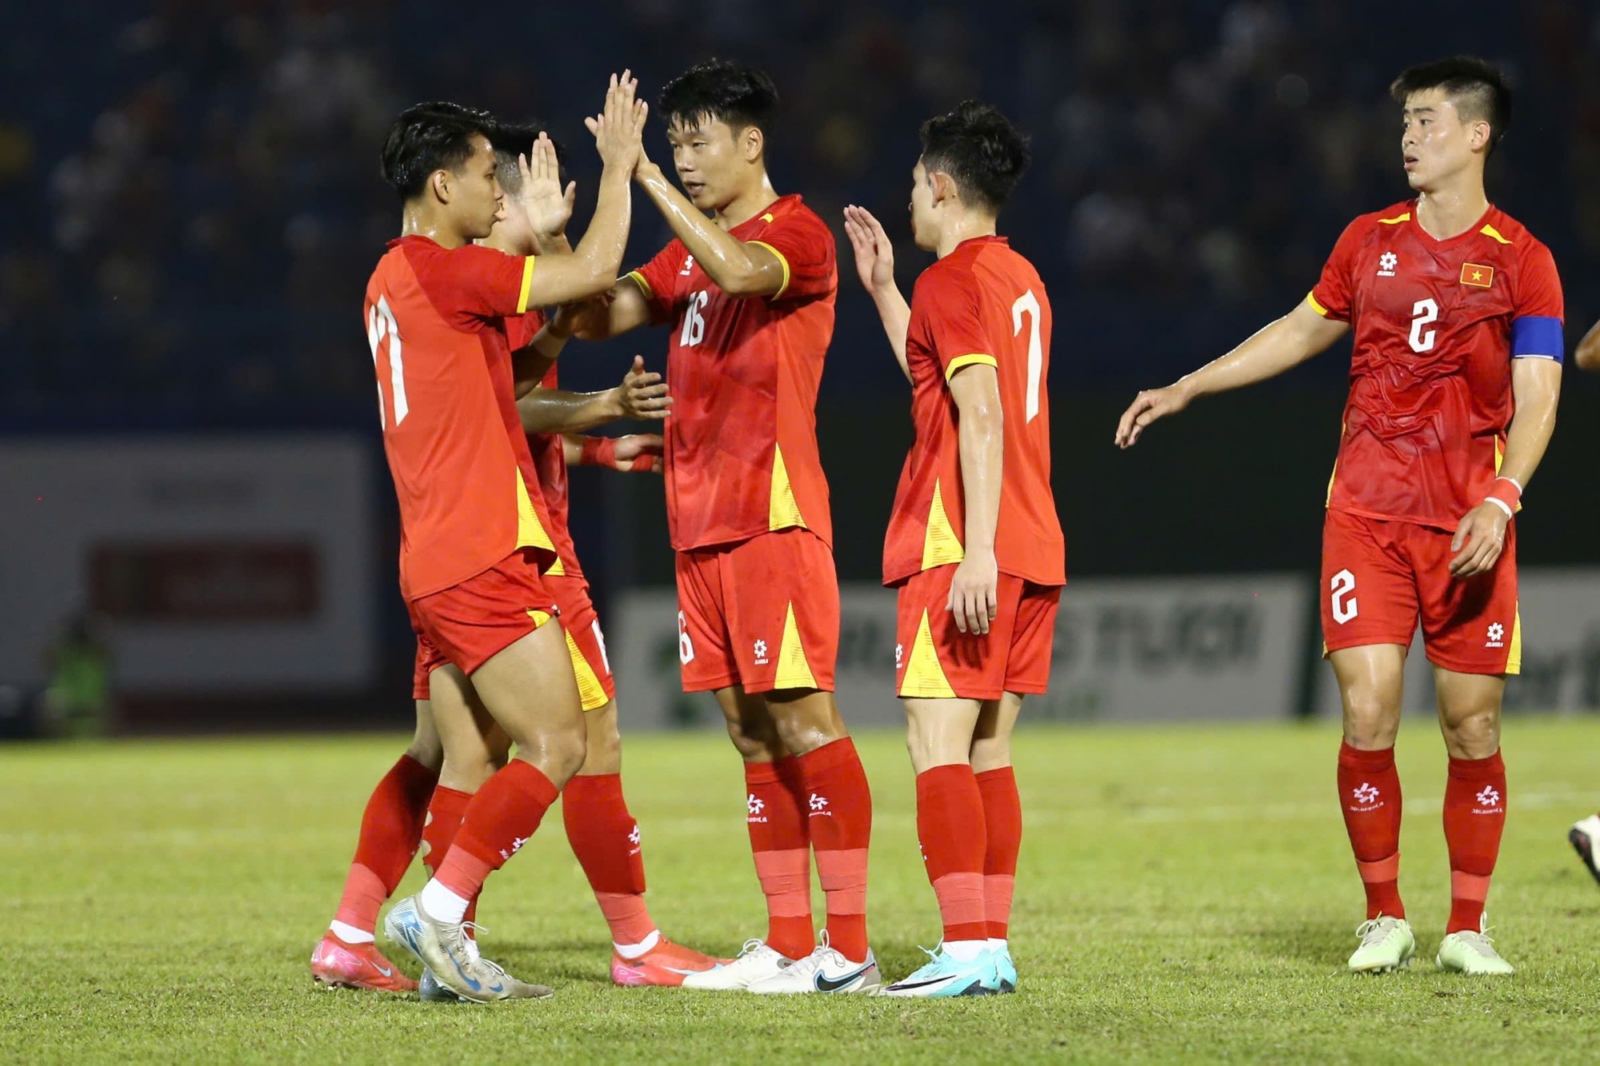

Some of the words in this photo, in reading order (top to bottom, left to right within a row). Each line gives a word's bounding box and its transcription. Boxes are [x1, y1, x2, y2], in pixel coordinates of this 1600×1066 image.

[680, 290, 708, 347] 16
[1408, 298, 1439, 353] 2
[1012, 288, 1042, 425] 7
[1331, 568, 1358, 625] 2
